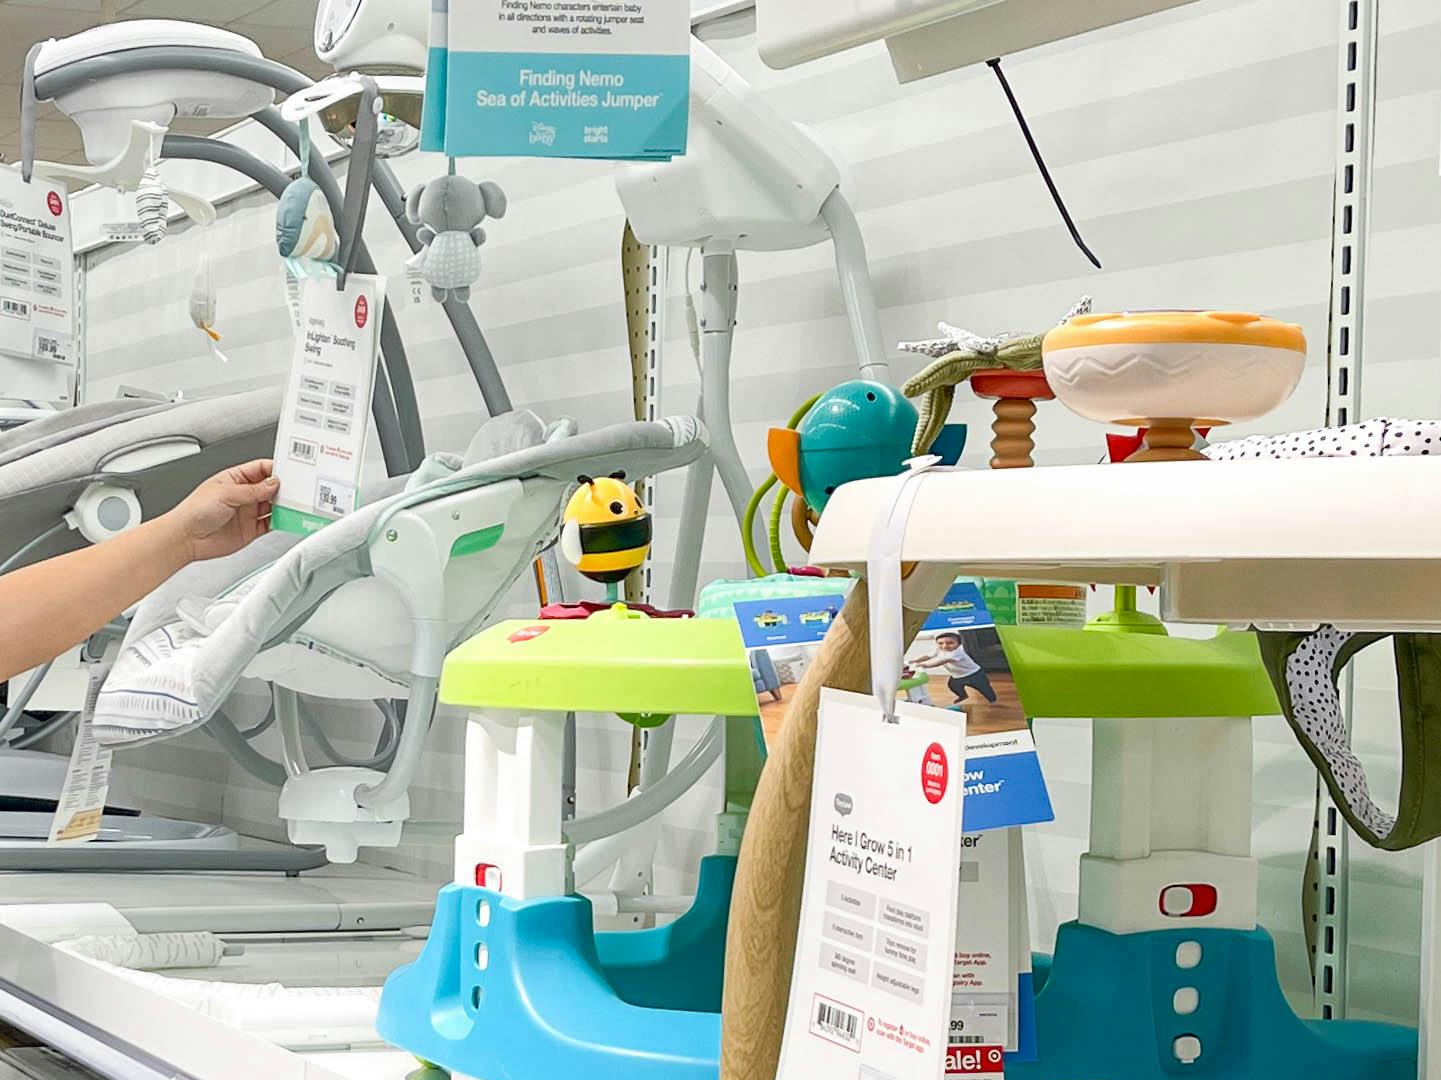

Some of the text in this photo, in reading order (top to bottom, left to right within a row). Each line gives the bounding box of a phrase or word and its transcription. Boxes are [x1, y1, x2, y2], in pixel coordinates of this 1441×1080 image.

[624, 4, 642, 14] baby
[498, 13, 506, 21] in
[516, 13, 551, 22] directions
[553, 14, 568, 23] with
[576, 15, 602, 25] rotating
[603, 16, 628, 26] jumper
[532, 26, 546, 34] and
[572, 26, 580, 34] of
[519, 69, 624, 89] Finding Nemo
[476, 90, 660, 110] Sea of Activities Jumper
[962, 770, 984, 782] ow
[962, 780, 1000, 797] enter
[831, 824, 853, 847] Here
[859, 832, 884, 854] Grow
[887, 840, 894, 858] 5
[895, 842, 904, 862] in
[829, 846, 897, 881] Activity Center
[949, 1020, 964, 1031] .99
